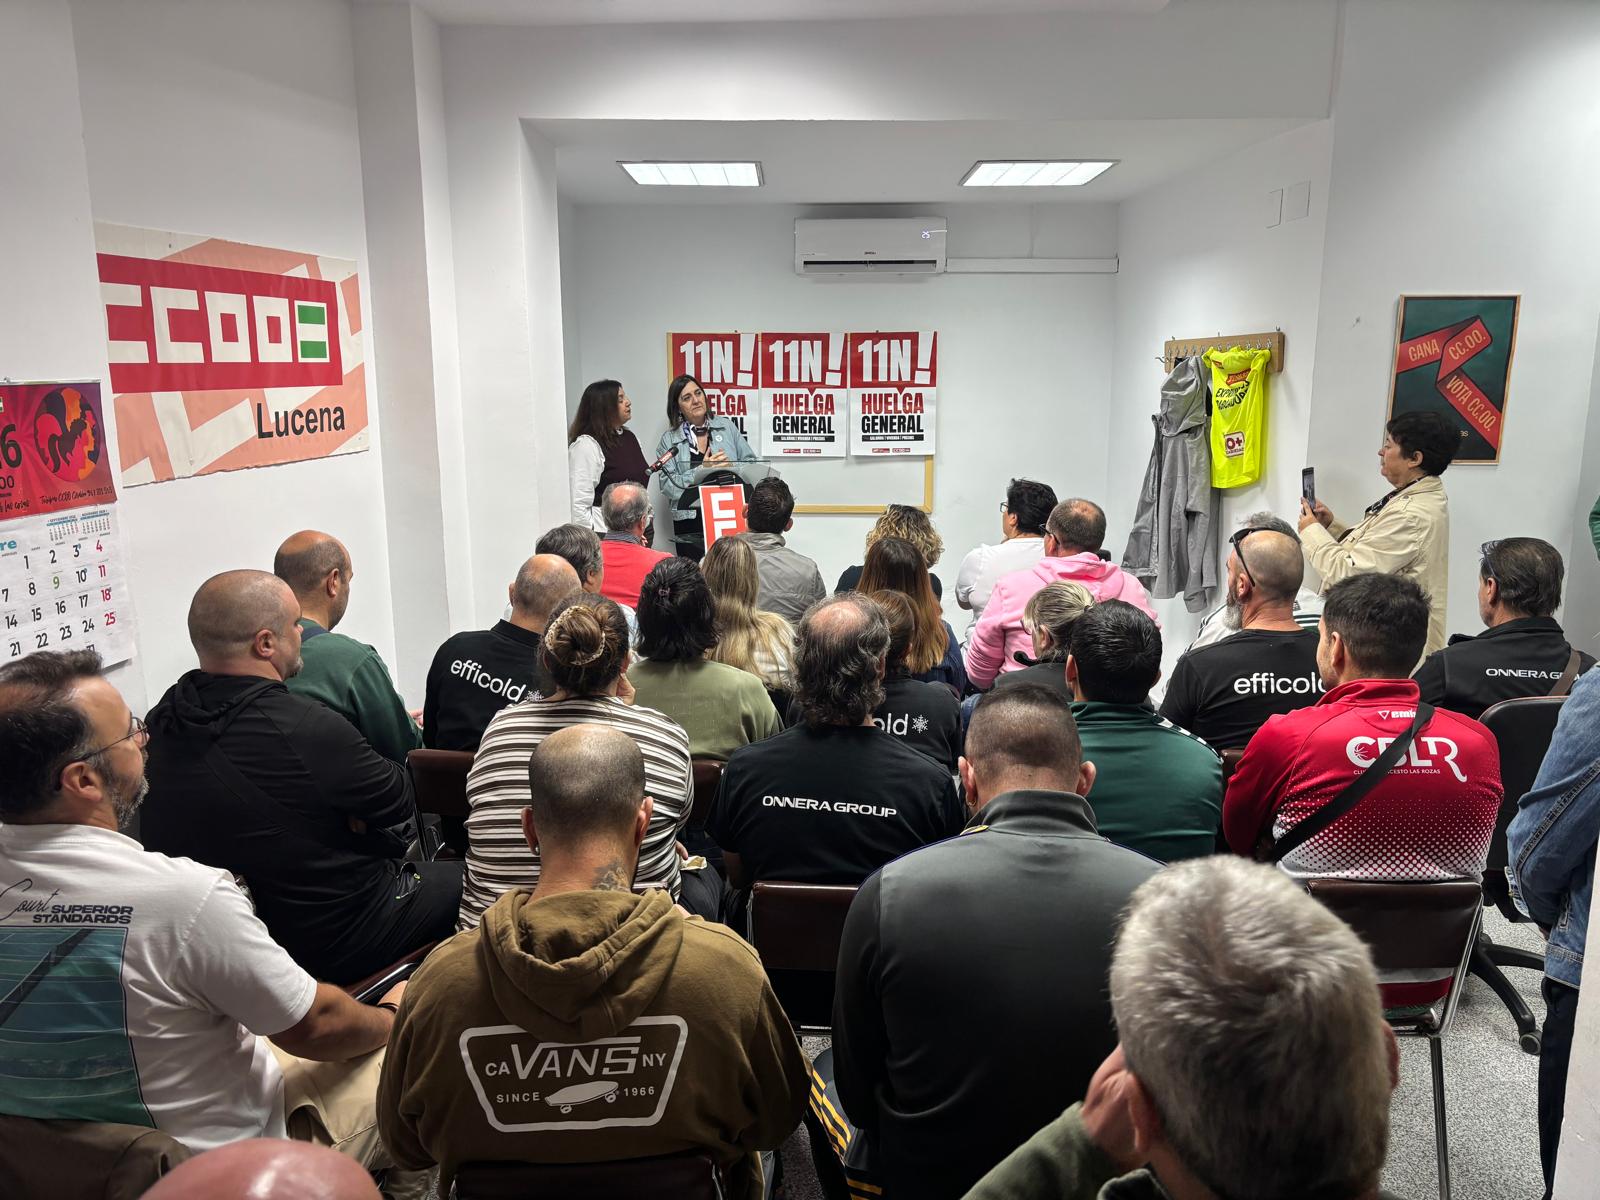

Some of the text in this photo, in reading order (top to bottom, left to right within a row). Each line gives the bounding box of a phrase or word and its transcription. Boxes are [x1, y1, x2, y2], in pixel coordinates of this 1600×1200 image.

[680, 332, 756, 387] 11N!
[769, 330, 845, 386] 11N!
[858, 330, 935, 385] 11N!
[1408, 338, 1440, 362] GANA
[1449, 329, 1486, 360] CC.OO.
[706, 394, 747, 416] ELGA
[772, 393, 835, 415] HUELGA
[861, 393, 924, 414] HUELGA
[1446, 375, 1497, 432] VOTA CC.OO.
[257, 403, 345, 439] Lucena
[772, 415, 835, 434] GENERAL
[861, 415, 924, 433] GENERAL
[0, 424, 22, 468] 6
[24, 540, 103, 569] 1 2 3 4
[2, 565, 106, 602] 7 8 9 10 11
[5, 588, 111, 629] 14 15 16 17 18
[10, 612, 116, 656] 21 22 23 24 25
[450, 659, 527, 702] efficold
[1485, 668, 1548, 679] ONNERA
[762, 795, 897, 818] ONNERA GROUP
[33, 913, 132, 924] STANDARDS
[51, 904, 134, 915] SUPERIOR
[485, 1036, 667, 1080] CA VANS NY
[496, 1086, 655, 1103] SINCE 1966
